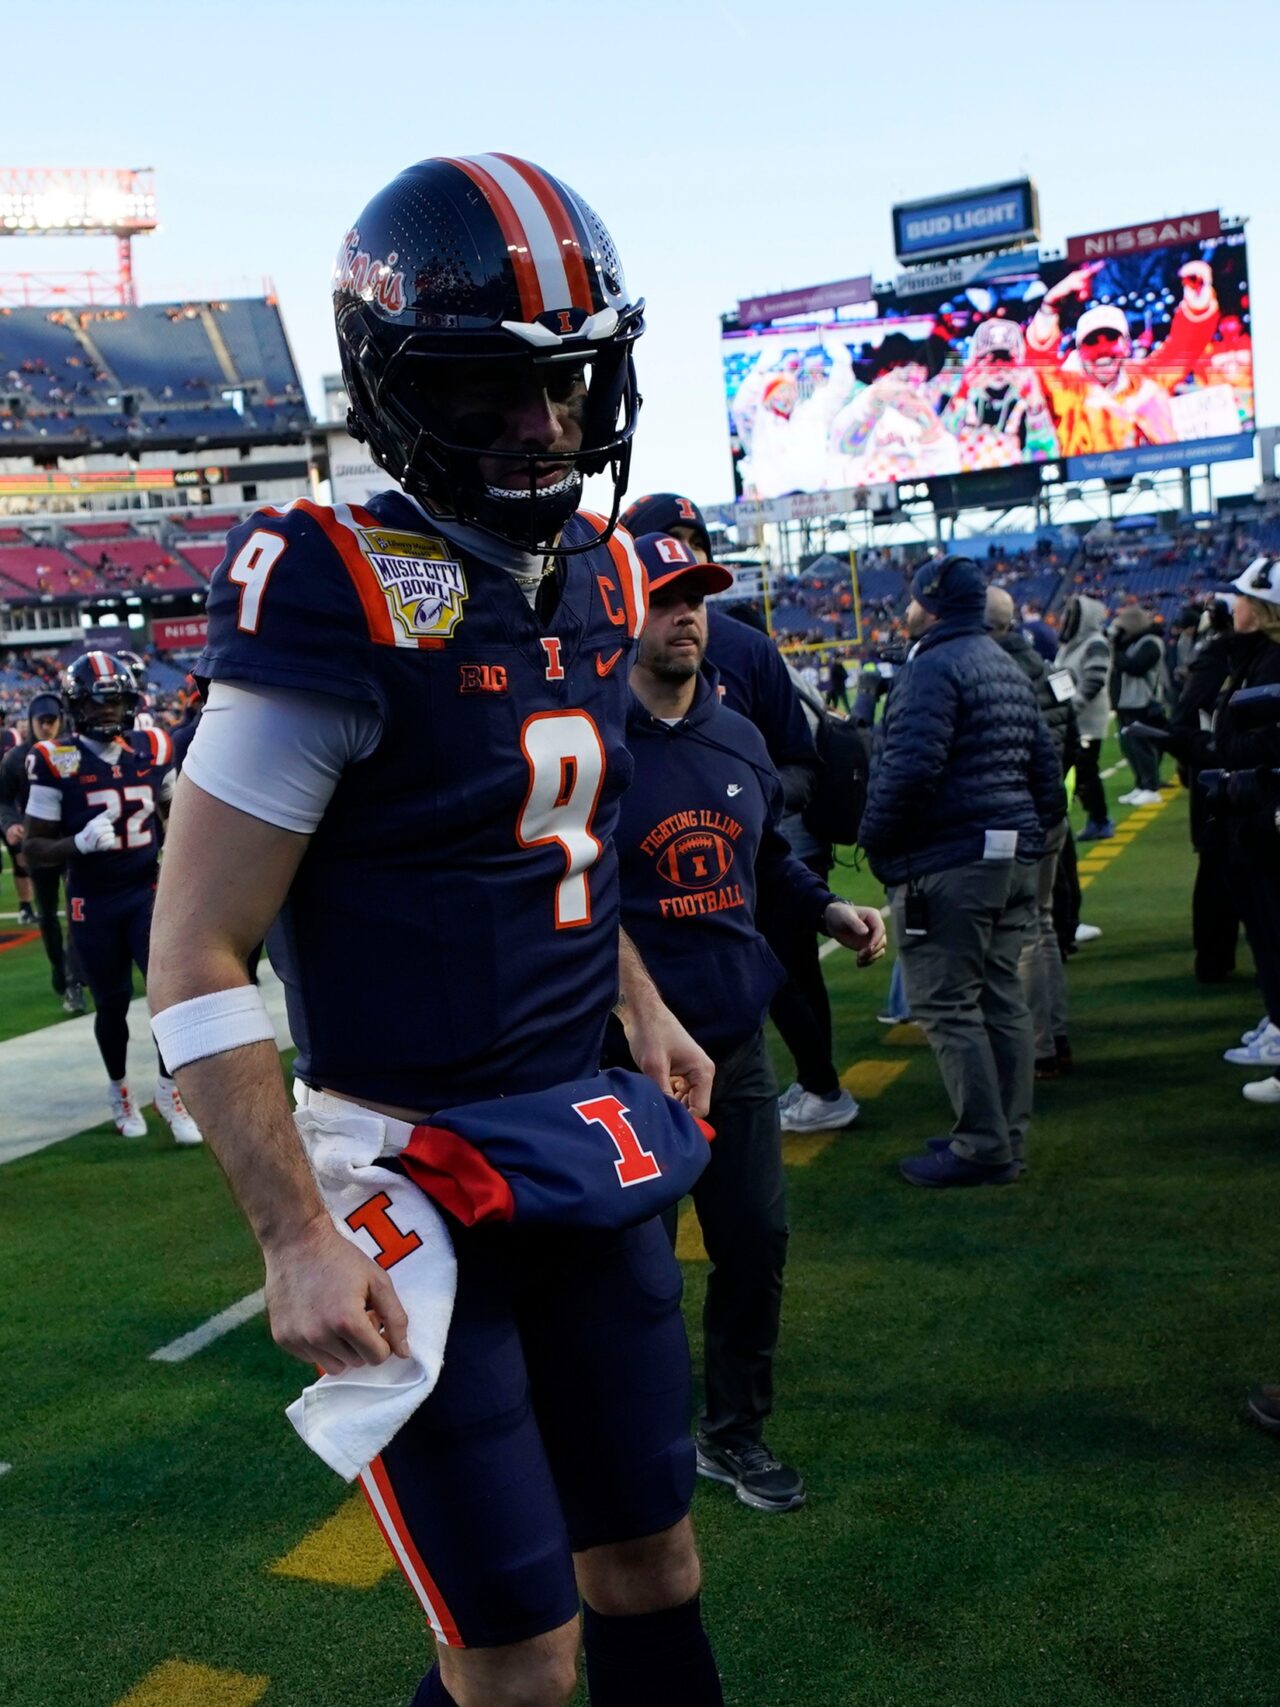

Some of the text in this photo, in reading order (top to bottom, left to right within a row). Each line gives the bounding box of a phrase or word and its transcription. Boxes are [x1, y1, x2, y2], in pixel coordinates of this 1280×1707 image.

[906, 202, 1017, 240] BUD LIGHT
[1084, 218, 1202, 256] NISSAN
[228, 528, 288, 635] 9
[372, 556, 460, 589] MUSIC CITY
[400, 580, 449, 602] BOWL
[597, 575, 626, 625] C
[540, 637, 564, 680] I
[516, 708, 606, 930] 9
[640, 809, 743, 857] FIGHTING ILLINI
[692, 855, 708, 877] I
[659, 884, 745, 918] FOOTBALL
[571, 1094, 663, 1188] I
[344, 1191, 424, 1271] I
